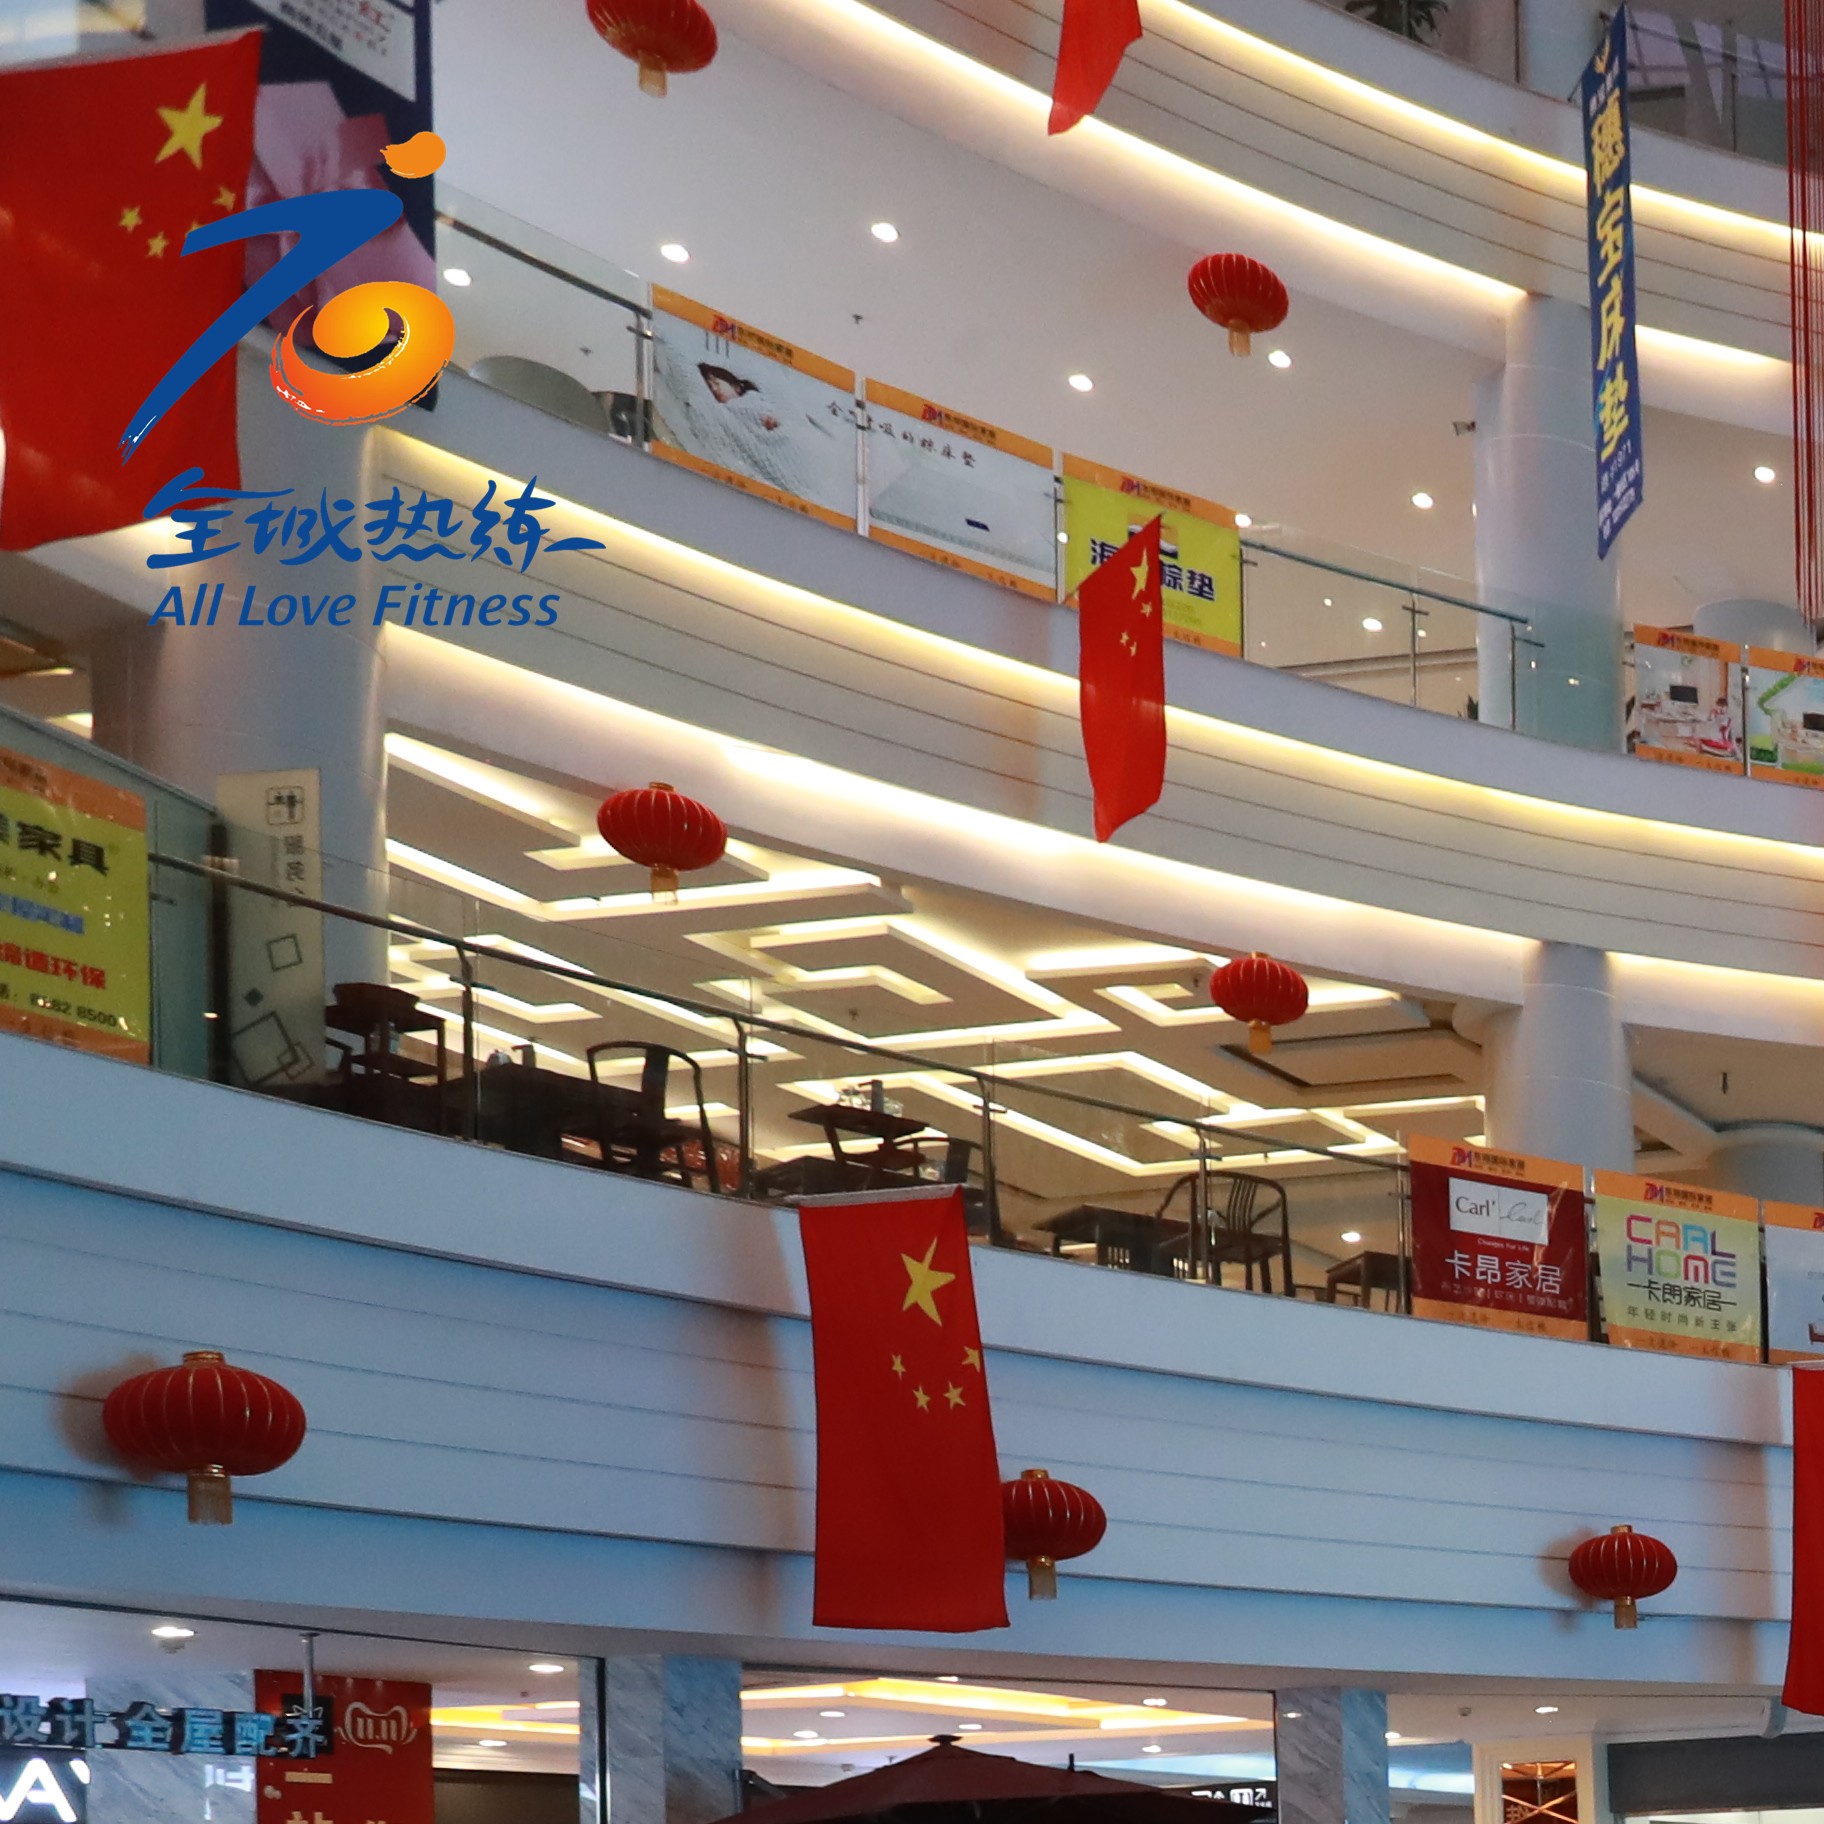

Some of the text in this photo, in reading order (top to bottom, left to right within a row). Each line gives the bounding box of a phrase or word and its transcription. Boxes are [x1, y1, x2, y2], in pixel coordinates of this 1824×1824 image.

[1445, 1249, 1563, 1295] 卡昂家居
[1626, 1243, 1737, 1289] HOME
[1626, 1279, 1737, 1313] 卡朗家居
[124, 1700, 326, 1759] 全屋配齐
